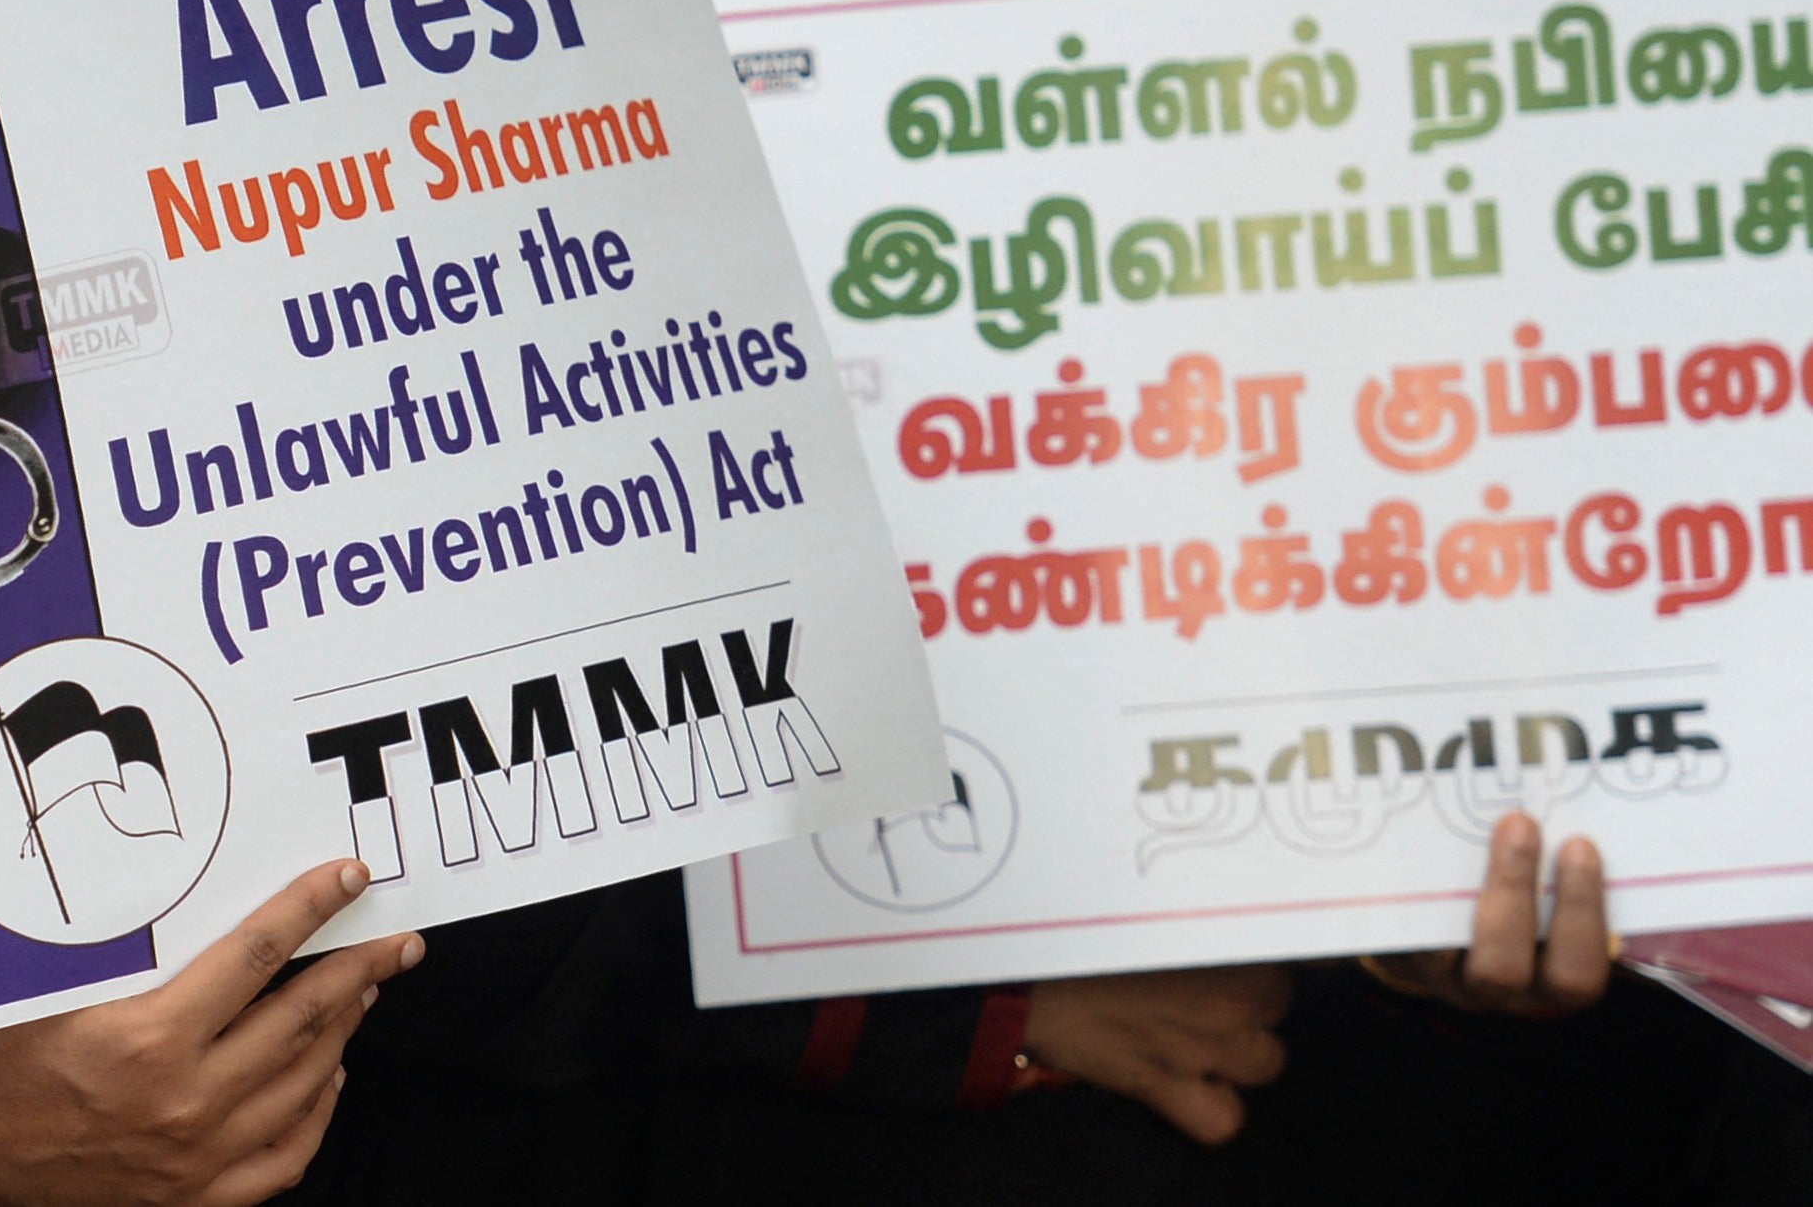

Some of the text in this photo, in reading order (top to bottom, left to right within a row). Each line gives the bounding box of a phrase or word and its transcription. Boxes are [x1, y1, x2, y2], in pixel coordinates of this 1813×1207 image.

[889, 1, 1813, 160] வள்ளல் நபியை
[147, 98, 670, 261] Nupur Sharma
[830, 166, 1505, 352] இழிவாய்ப்
[10, 267, 148, 332] TMMK
[53, 322, 134, 362] MEDIA
[282, 206, 635, 358] under the
[107, 310, 809, 528] Unlawful Activities
[897, 357, 1304, 484] வக்கிர
[200, 430, 805, 665] (Prevention) Act
[307, 616, 842, 885] TMMK
